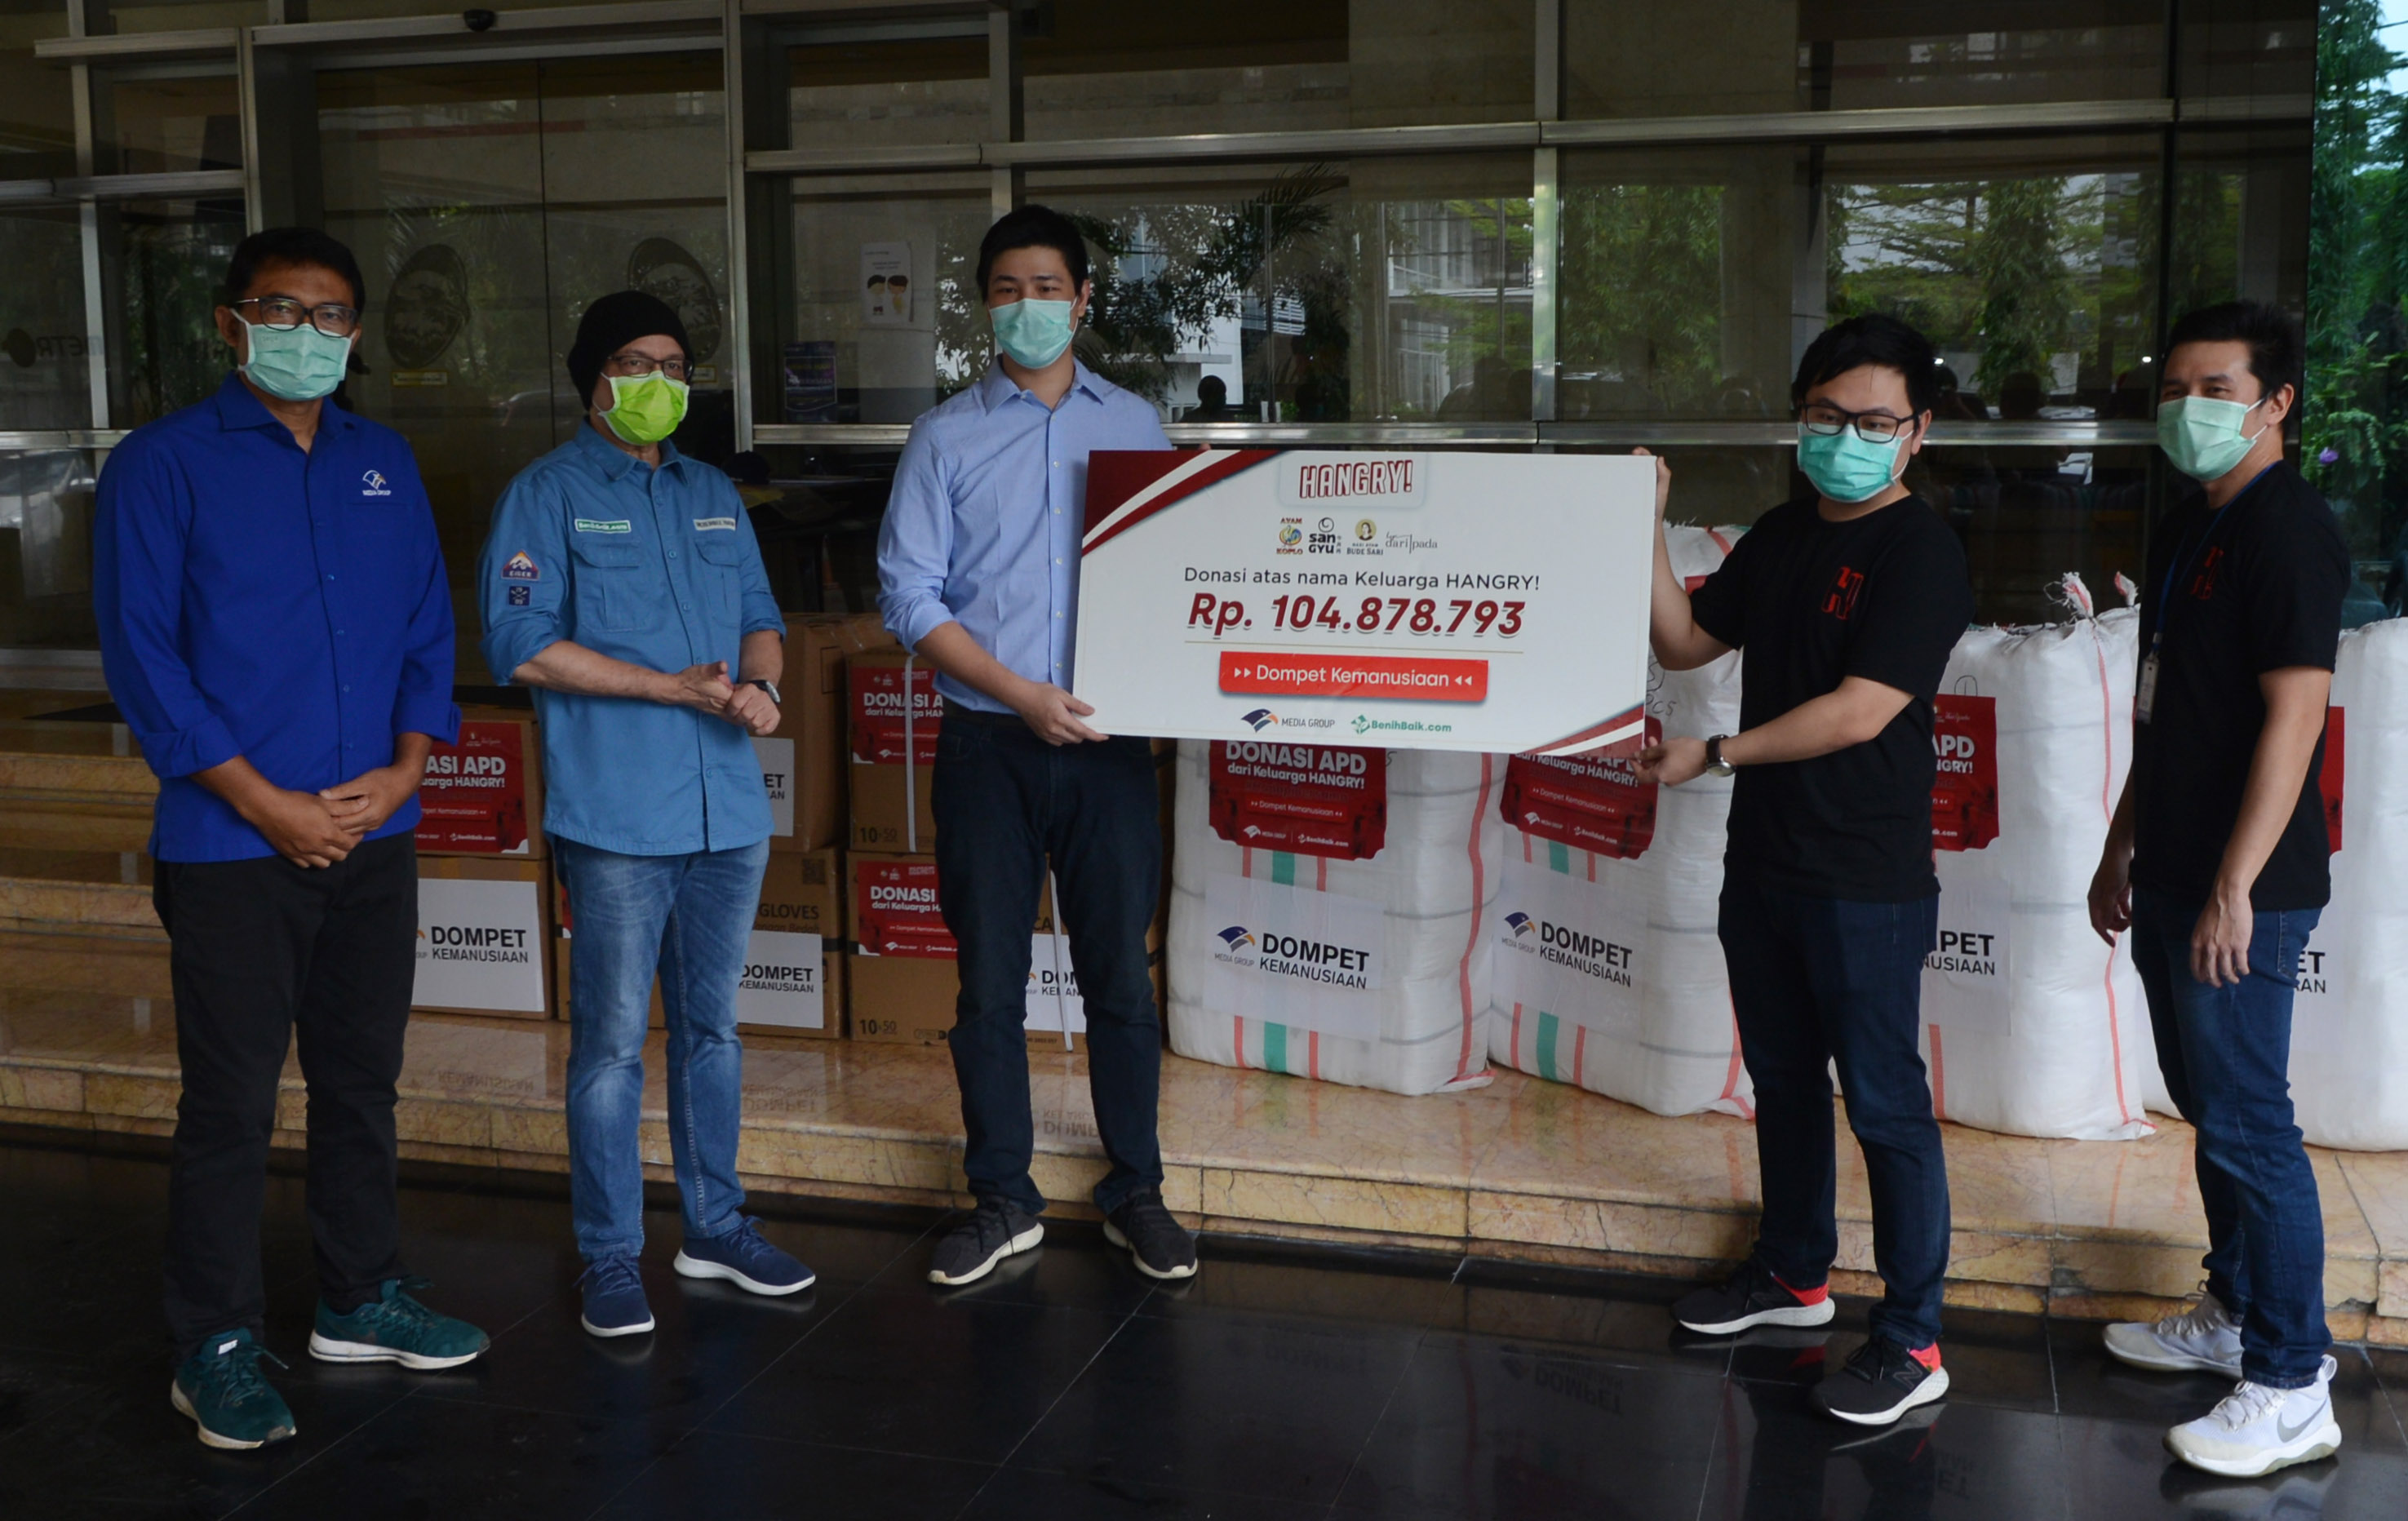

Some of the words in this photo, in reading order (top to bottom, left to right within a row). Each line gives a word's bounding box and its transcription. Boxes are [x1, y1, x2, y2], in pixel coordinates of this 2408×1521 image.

[1299, 459, 1413, 499] HANGRY!
[1309, 533, 1336, 543] san
[1184, 567, 1246, 583] Donasi
[1253, 570, 1291, 585] atas
[1297, 573, 1348, 586] nama
[1355, 571, 1439, 589] Keluarga
[1447, 574, 1540, 591] HANGRY!
[1187, 592, 1253, 637] Rp.
[1271, 594, 1526, 636] 104.878.793
[1257, 665, 1326, 685] Dompet
[1331, 667, 1449, 687] Kemanusiaan
[863, 692, 929, 707] DONSI
[865, 707, 883, 716] dari
[1282, 718, 1306, 727] MEDIA
[1308, 719, 1335, 729] GROUP
[1371, 720, 1452, 733] BenihBaik.com
[463, 756, 506, 775] APD
[1226, 741, 1313, 770] DONASI
[1319, 751, 1367, 774] APD
[1537, 754, 1585, 775] Keluarga
[455, 777, 505, 788] HANGRY!
[1227, 762, 1251, 776] dari
[1253, 765, 1306, 784] Keluarga
[1309, 772, 1365, 789] HANGRY!
[1540, 787, 1564, 801] Dompet
[1259, 800, 1287, 811] Dompet
[1288, 804, 1334, 817] Kemanusiaan
[860, 827, 877, 843] 10
[870, 885, 935, 902] DONASI
[759, 902, 819, 920] GLOVES
[871, 901, 889, 909] dari
[891, 902, 930, 913] Keluarga
[431, 926, 526, 948] DOMPET
[1541, 920, 1632, 970] DOMPET
[1936, 930, 1994, 956] PET
[432, 947, 529, 964] KEMANUSIAAN
[1214, 953, 1233, 964] MEDIA
[1235, 956, 1254, 967] GROUP
[1262, 933, 1369, 972] DOMPET
[1260, 957, 1367, 990] KEMANUSIAAN
[1540, 945, 1631, 988] KEMANUSIAAN
[860, 1019, 877, 1035] 10
